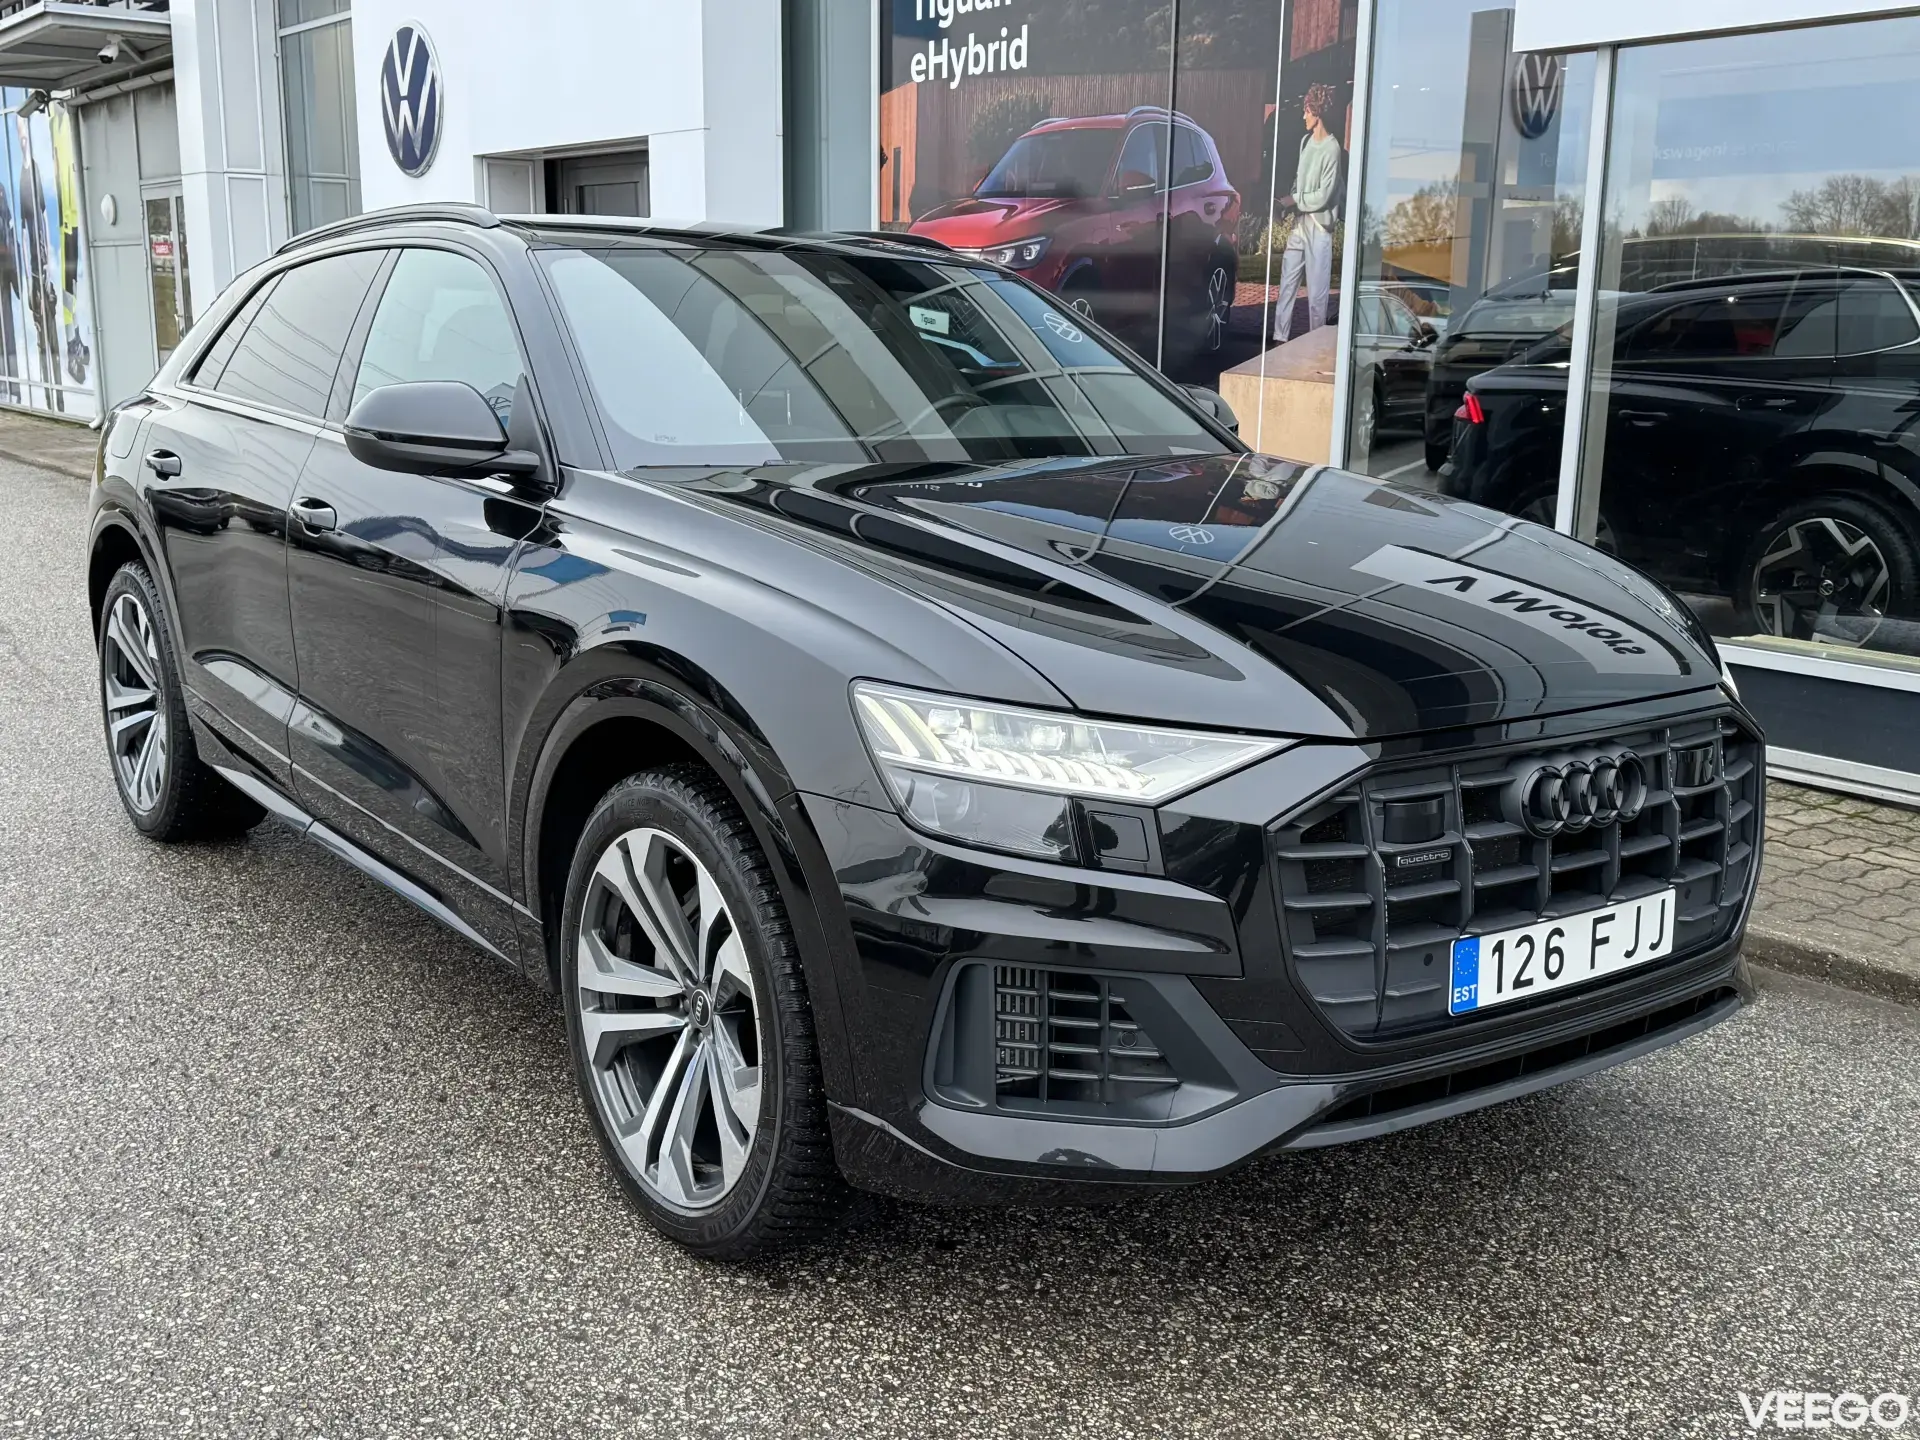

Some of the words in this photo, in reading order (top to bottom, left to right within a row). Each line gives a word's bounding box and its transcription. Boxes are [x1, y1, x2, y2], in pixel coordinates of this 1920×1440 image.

[910, 24, 1028, 89] eHybrid
[1400, 852, 1449, 865] quattro
[1491, 927, 1566, 994] 126
[1589, 898, 1667, 971] FJJ
[1453, 983, 1478, 1003] EST
